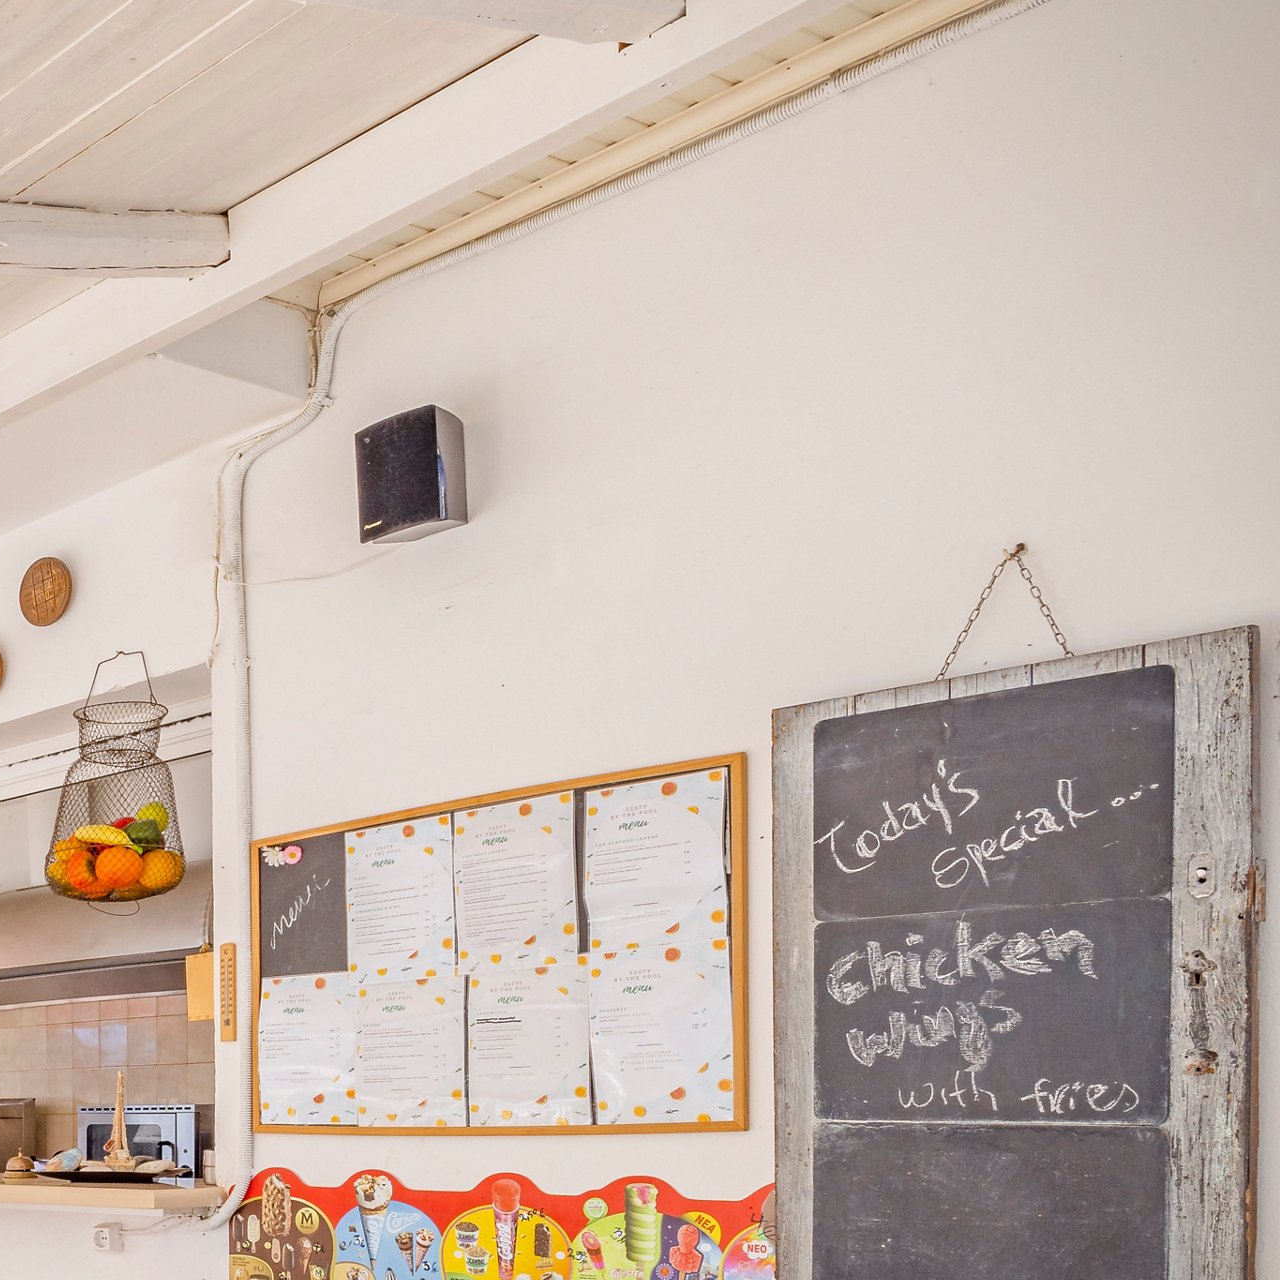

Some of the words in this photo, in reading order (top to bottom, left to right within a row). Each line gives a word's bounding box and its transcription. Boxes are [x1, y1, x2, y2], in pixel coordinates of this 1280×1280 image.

[813, 759, 980, 874] Today's
[619, 820, 649, 830] menu
[932, 778, 1099, 888] Special
[482, 836, 508, 846] menu
[372, 858, 395, 868] menu
[826, 914, 1098, 1005] Chicken
[623, 984, 653, 994] menu
[497, 996, 523, 1004] menu
[283, 1006, 304, 1015] menu
[382, 1005, 405, 1013] menu
[898, 1071, 998, 1111] with
[1020, 1079, 1139, 1114] fries
